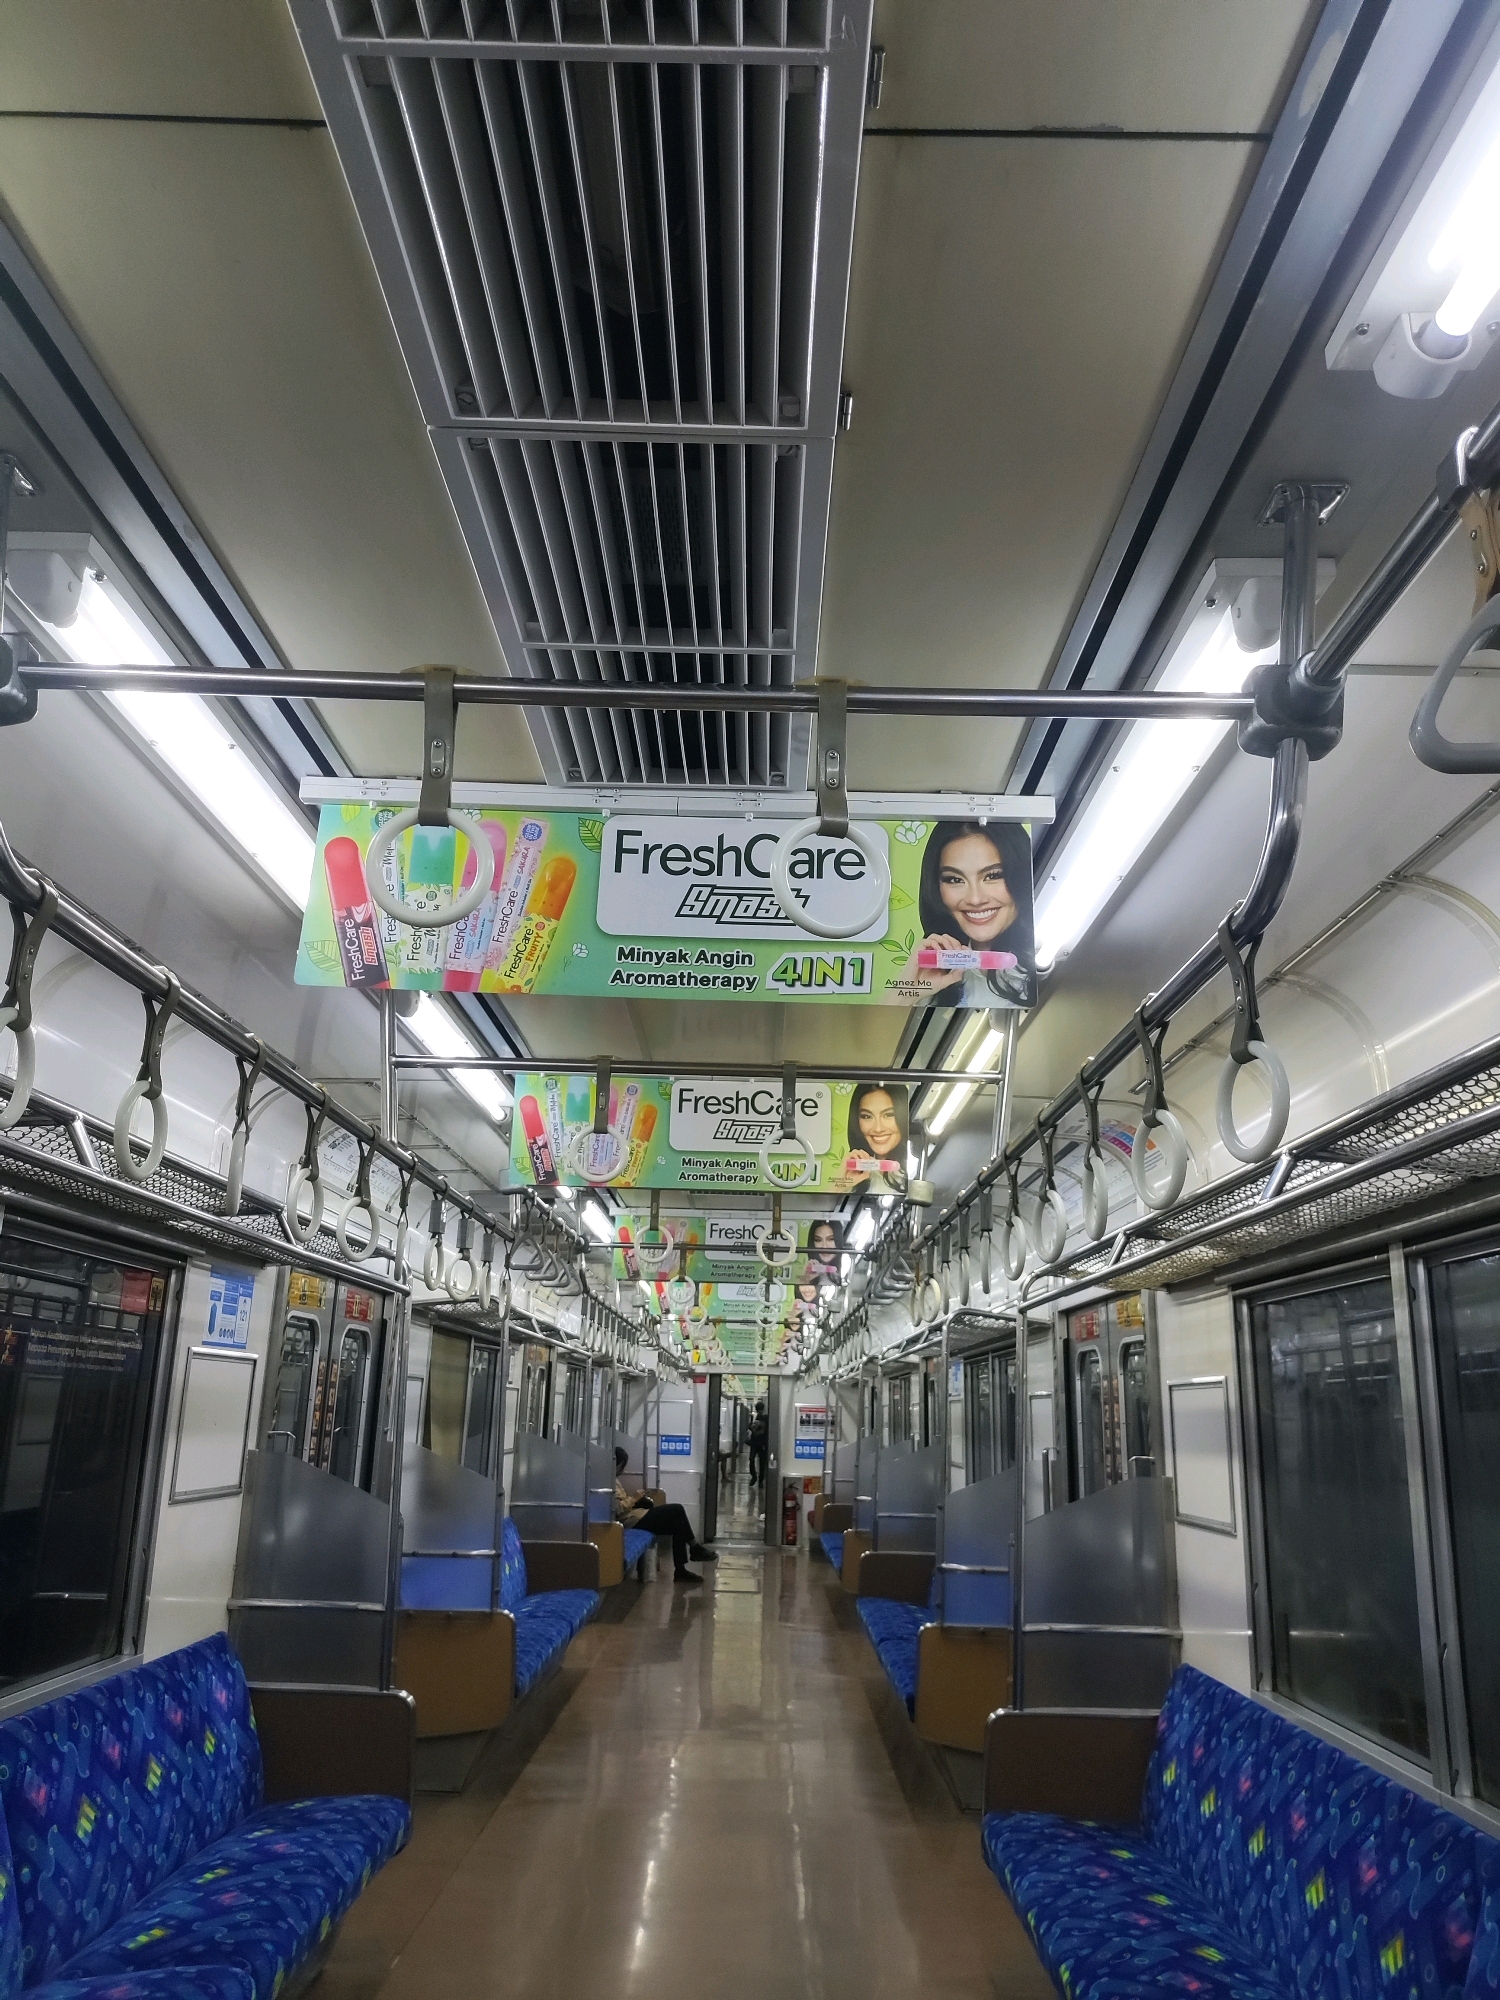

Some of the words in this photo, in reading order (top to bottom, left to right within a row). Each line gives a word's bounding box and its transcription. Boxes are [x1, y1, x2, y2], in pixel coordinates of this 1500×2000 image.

[493, 889, 519, 944] FreshCare
[344, 918, 366, 981] FreshCare
[504, 928, 534, 979] FreshCare
[525, 932, 544, 962] FRUITY
[616, 946, 691, 969] Minyak
[694, 948, 754, 969] Angin
[609, 969, 759, 993] Aromatherapy
[770, 956, 866, 988] 4IN1
[885, 979, 915, 987] Agnez
[917, 979, 932, 987] Mo
[897, 989, 920, 997] Artis
[682, 1157, 724, 1170] Minyak
[725, 1158, 757, 1170] Angin
[678, 1171, 759, 1185] Aromatherapy
[710, 1271, 756, 1279] Aromatherapy
